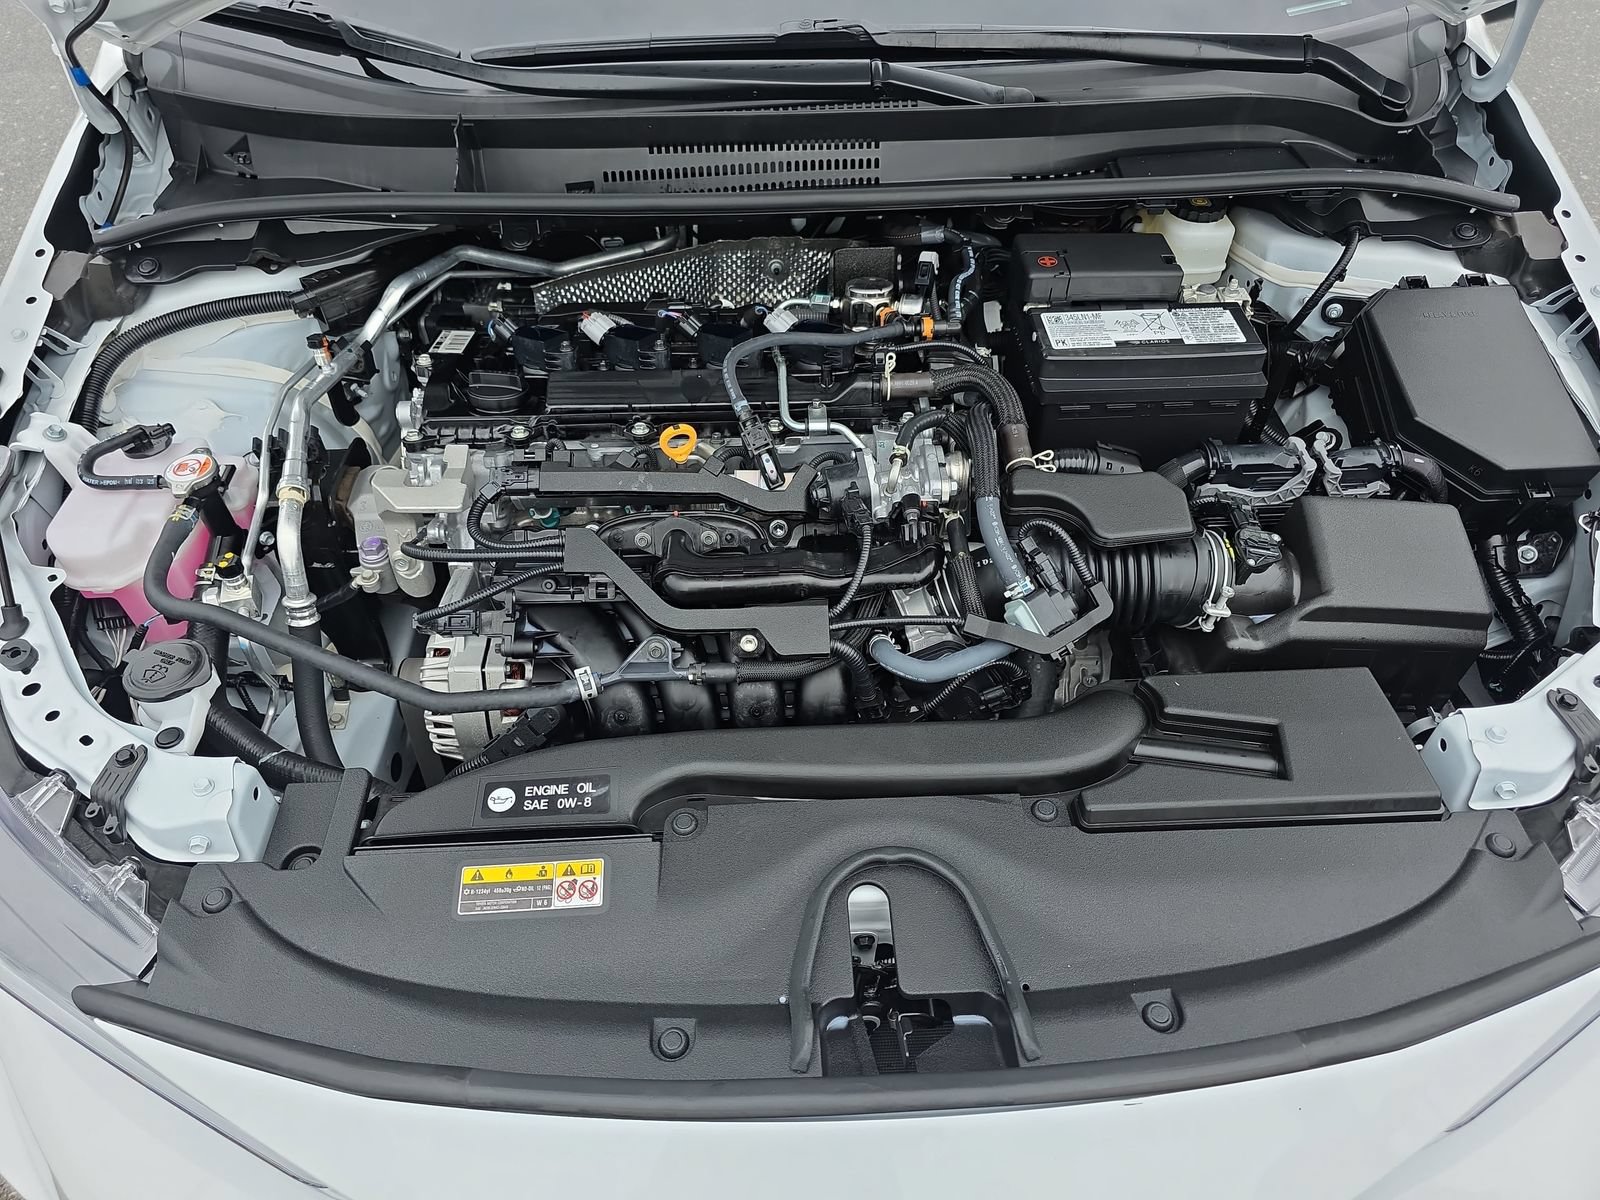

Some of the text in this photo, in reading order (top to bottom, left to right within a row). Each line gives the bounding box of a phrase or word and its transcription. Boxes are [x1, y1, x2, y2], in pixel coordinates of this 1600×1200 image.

[1054, 338, 1068, 347] PK
[524, 782, 597, 797] ENGINE OIL
[523, 796, 592, 811] SAE 0W-8
